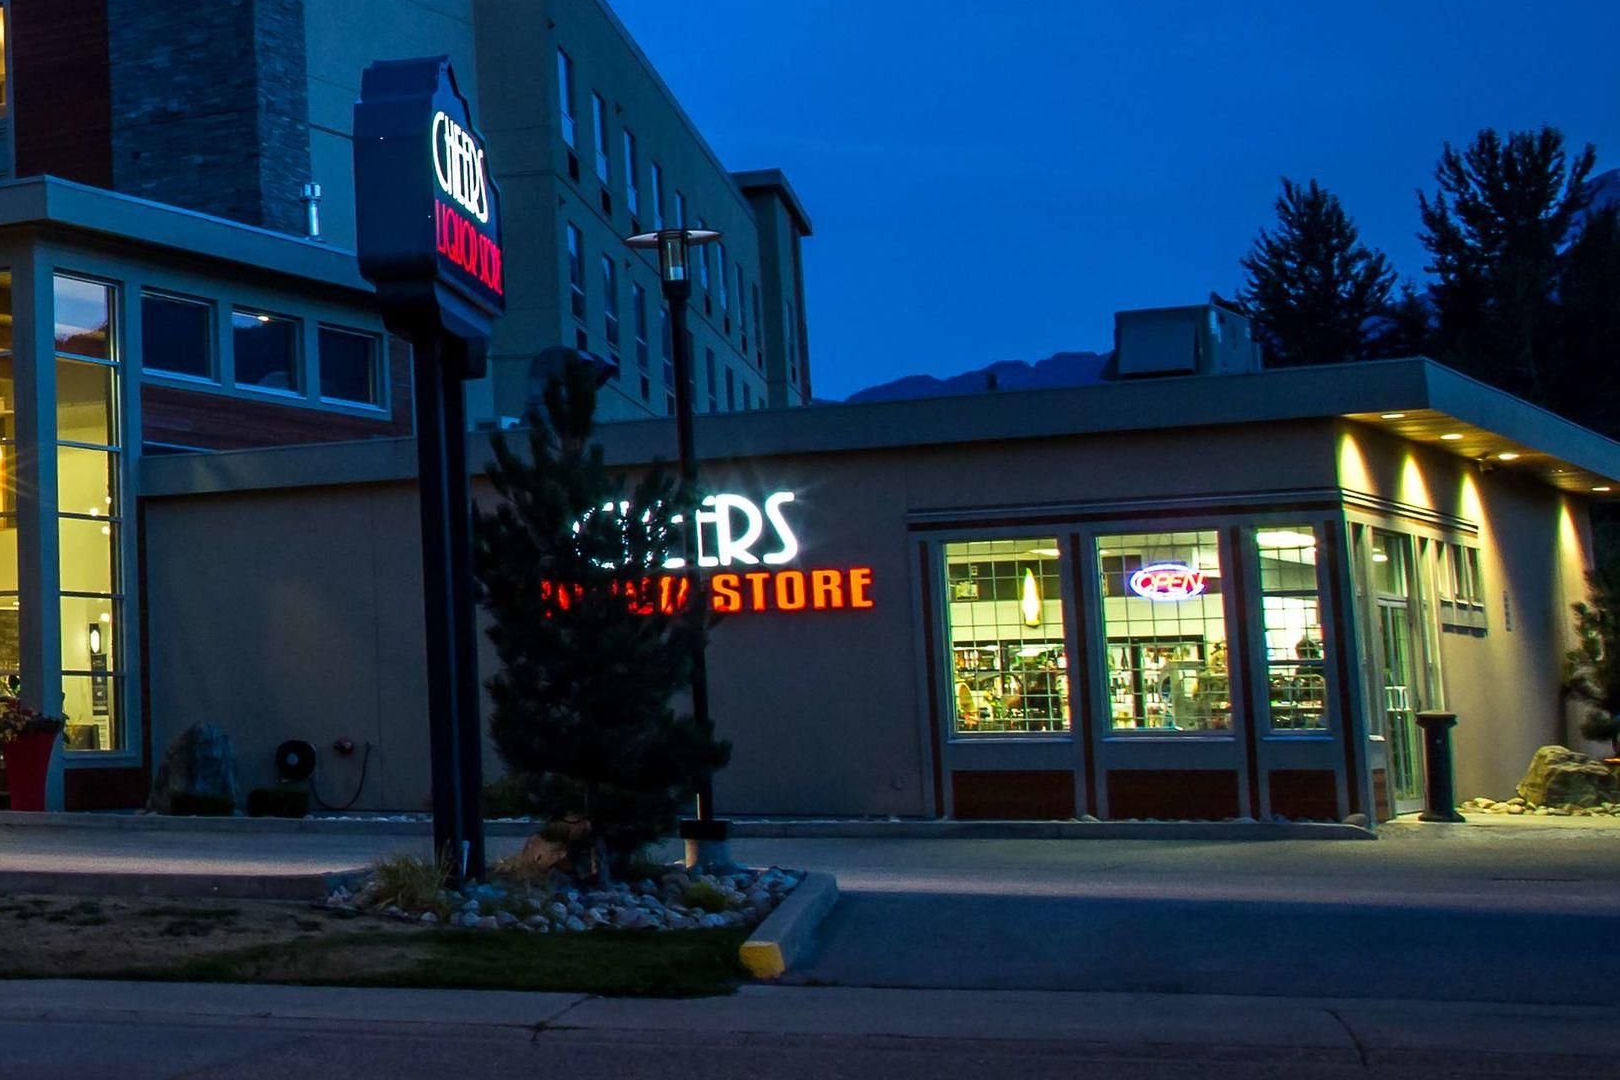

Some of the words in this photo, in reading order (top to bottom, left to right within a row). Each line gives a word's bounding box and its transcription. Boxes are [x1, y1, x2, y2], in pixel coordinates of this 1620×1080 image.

[572, 492, 798, 569] CERS
[712, 568, 874, 612] STORE
[1137, 573, 1204, 594] OPEN
